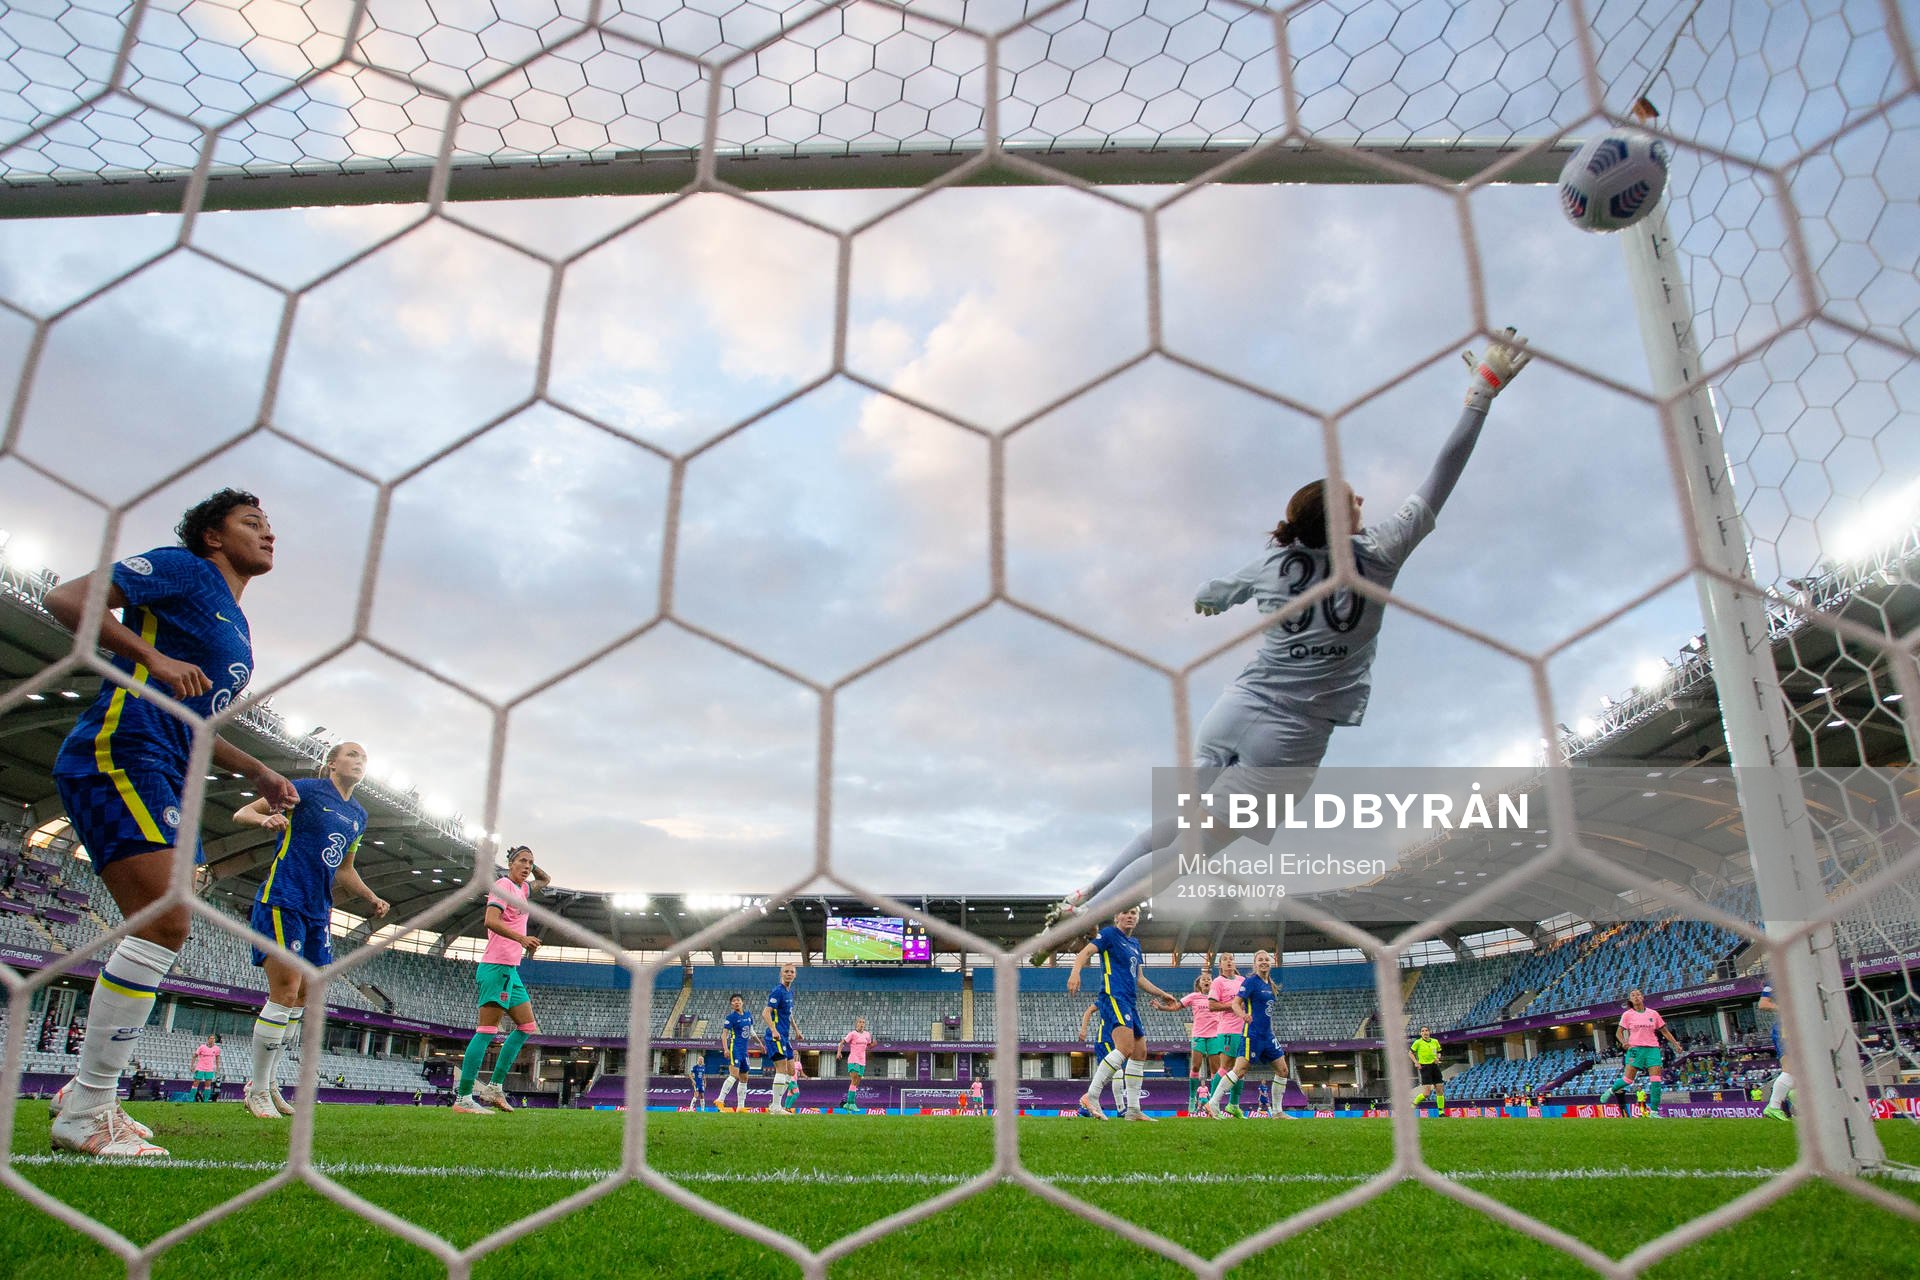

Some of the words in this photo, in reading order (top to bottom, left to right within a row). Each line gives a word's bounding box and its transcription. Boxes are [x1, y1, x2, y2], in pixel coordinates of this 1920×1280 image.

[1280, 551, 1364, 633] 30
[1311, 646, 1348, 656] PLAN
[1, 949, 43, 962] GOTHENBURG
[502, 974, 511, 991] 7
[1668, 1108, 1691, 1118] FINAL
